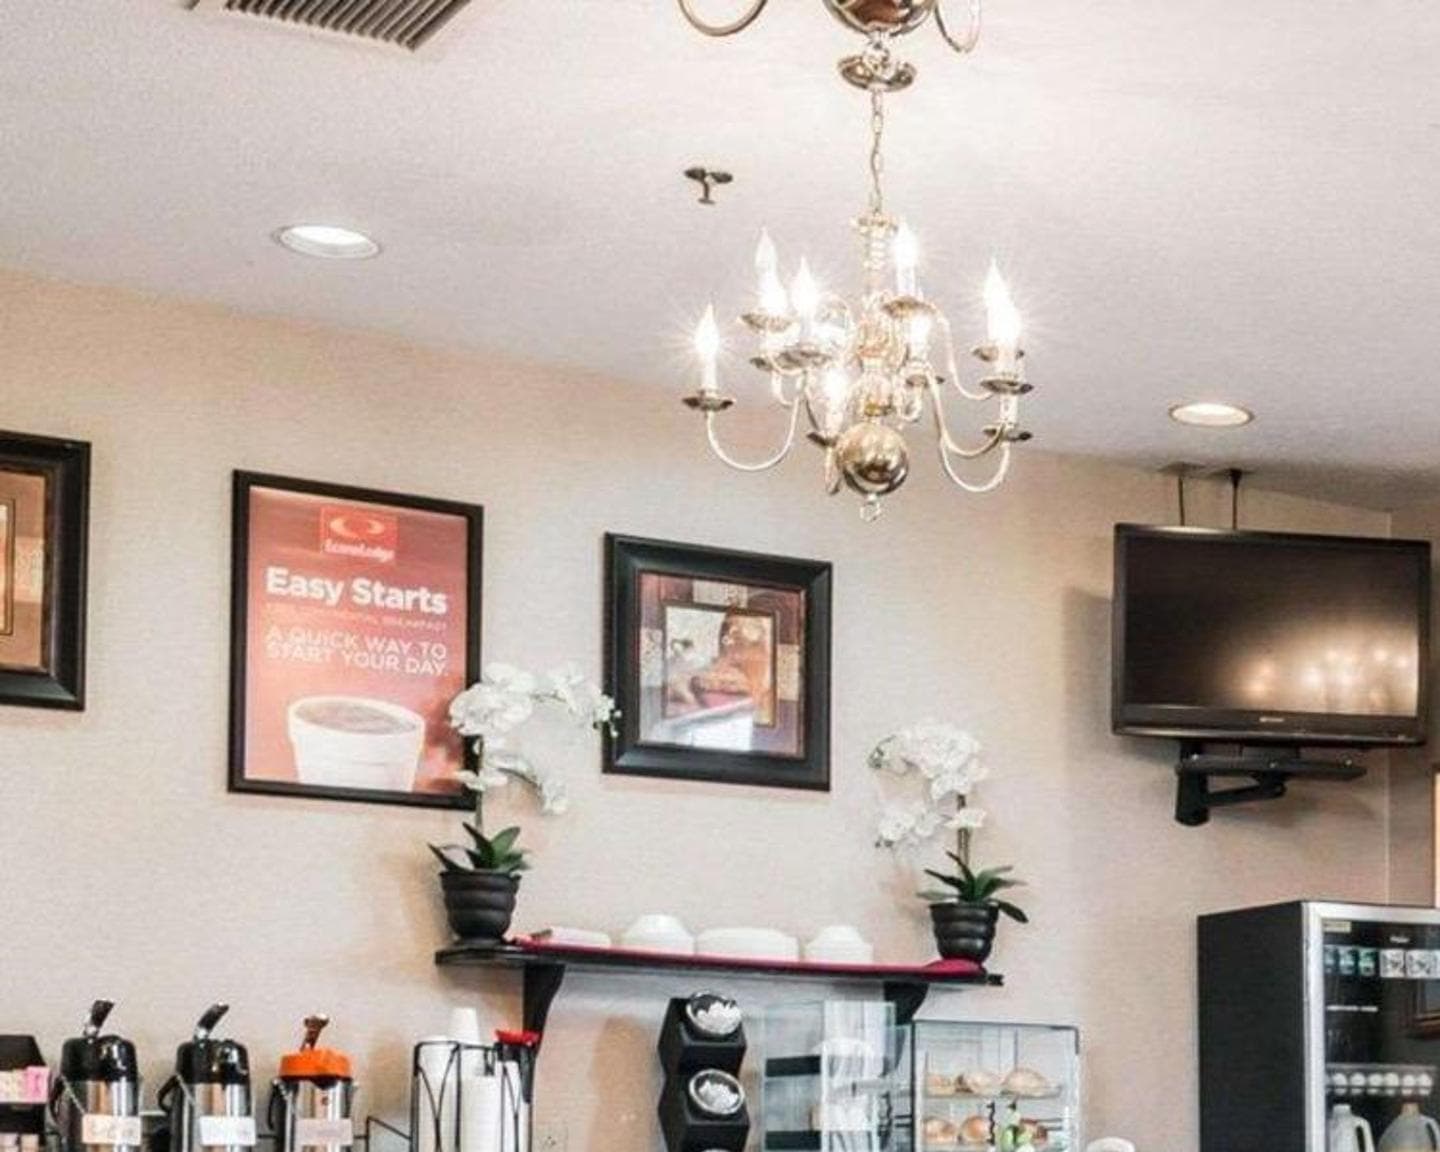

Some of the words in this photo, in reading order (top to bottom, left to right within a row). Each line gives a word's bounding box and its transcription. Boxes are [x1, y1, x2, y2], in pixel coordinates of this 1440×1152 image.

[266, 566, 344, 606] Easy
[351, 577, 448, 614] Starts
[266, 640, 332, 663] START
[342, 650, 400, 670] YOUR
[404, 657, 449, 677] DAY.
[267, 625, 283, 642] A
[289, 625, 360, 650] QUICK
[363, 635, 413, 656] WAY
[420, 640, 447, 660] TO
